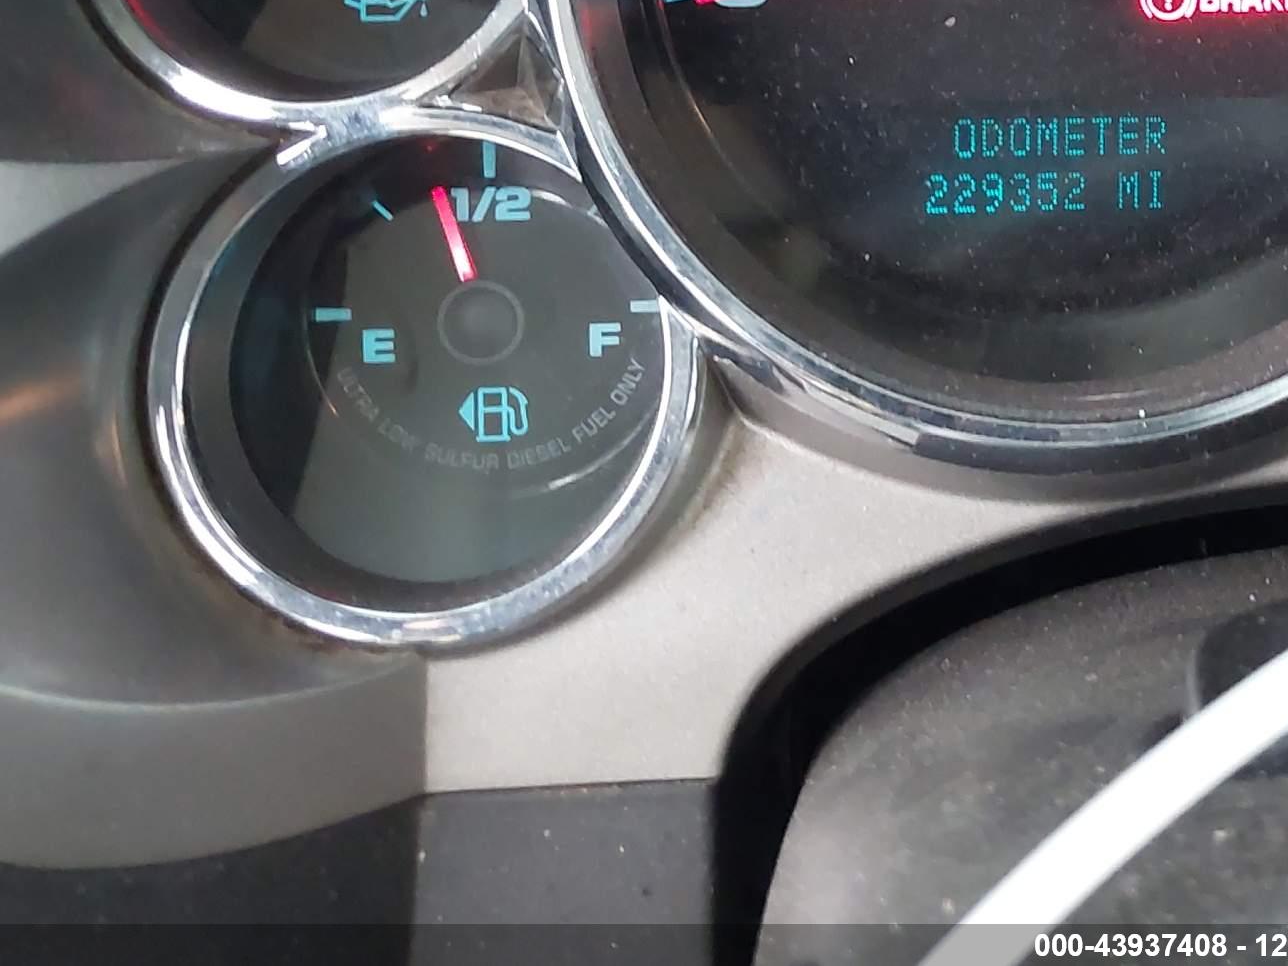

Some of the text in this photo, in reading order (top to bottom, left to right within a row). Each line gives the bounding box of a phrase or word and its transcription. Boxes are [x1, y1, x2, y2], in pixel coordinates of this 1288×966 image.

[953, 117, 1167, 158] ODOMETER
[451, 186, 532, 223] 1/2
[925, 170, 1162, 214] 229352 MI
[362, 328, 396, 364] E
[588, 322, 621, 357] F
[424, 441, 499, 470] SULFUR
[506, 436, 573, 470] DIESEL
[571, 407, 617, 444] FUEL
[610, 356, 646, 406] ONLY
